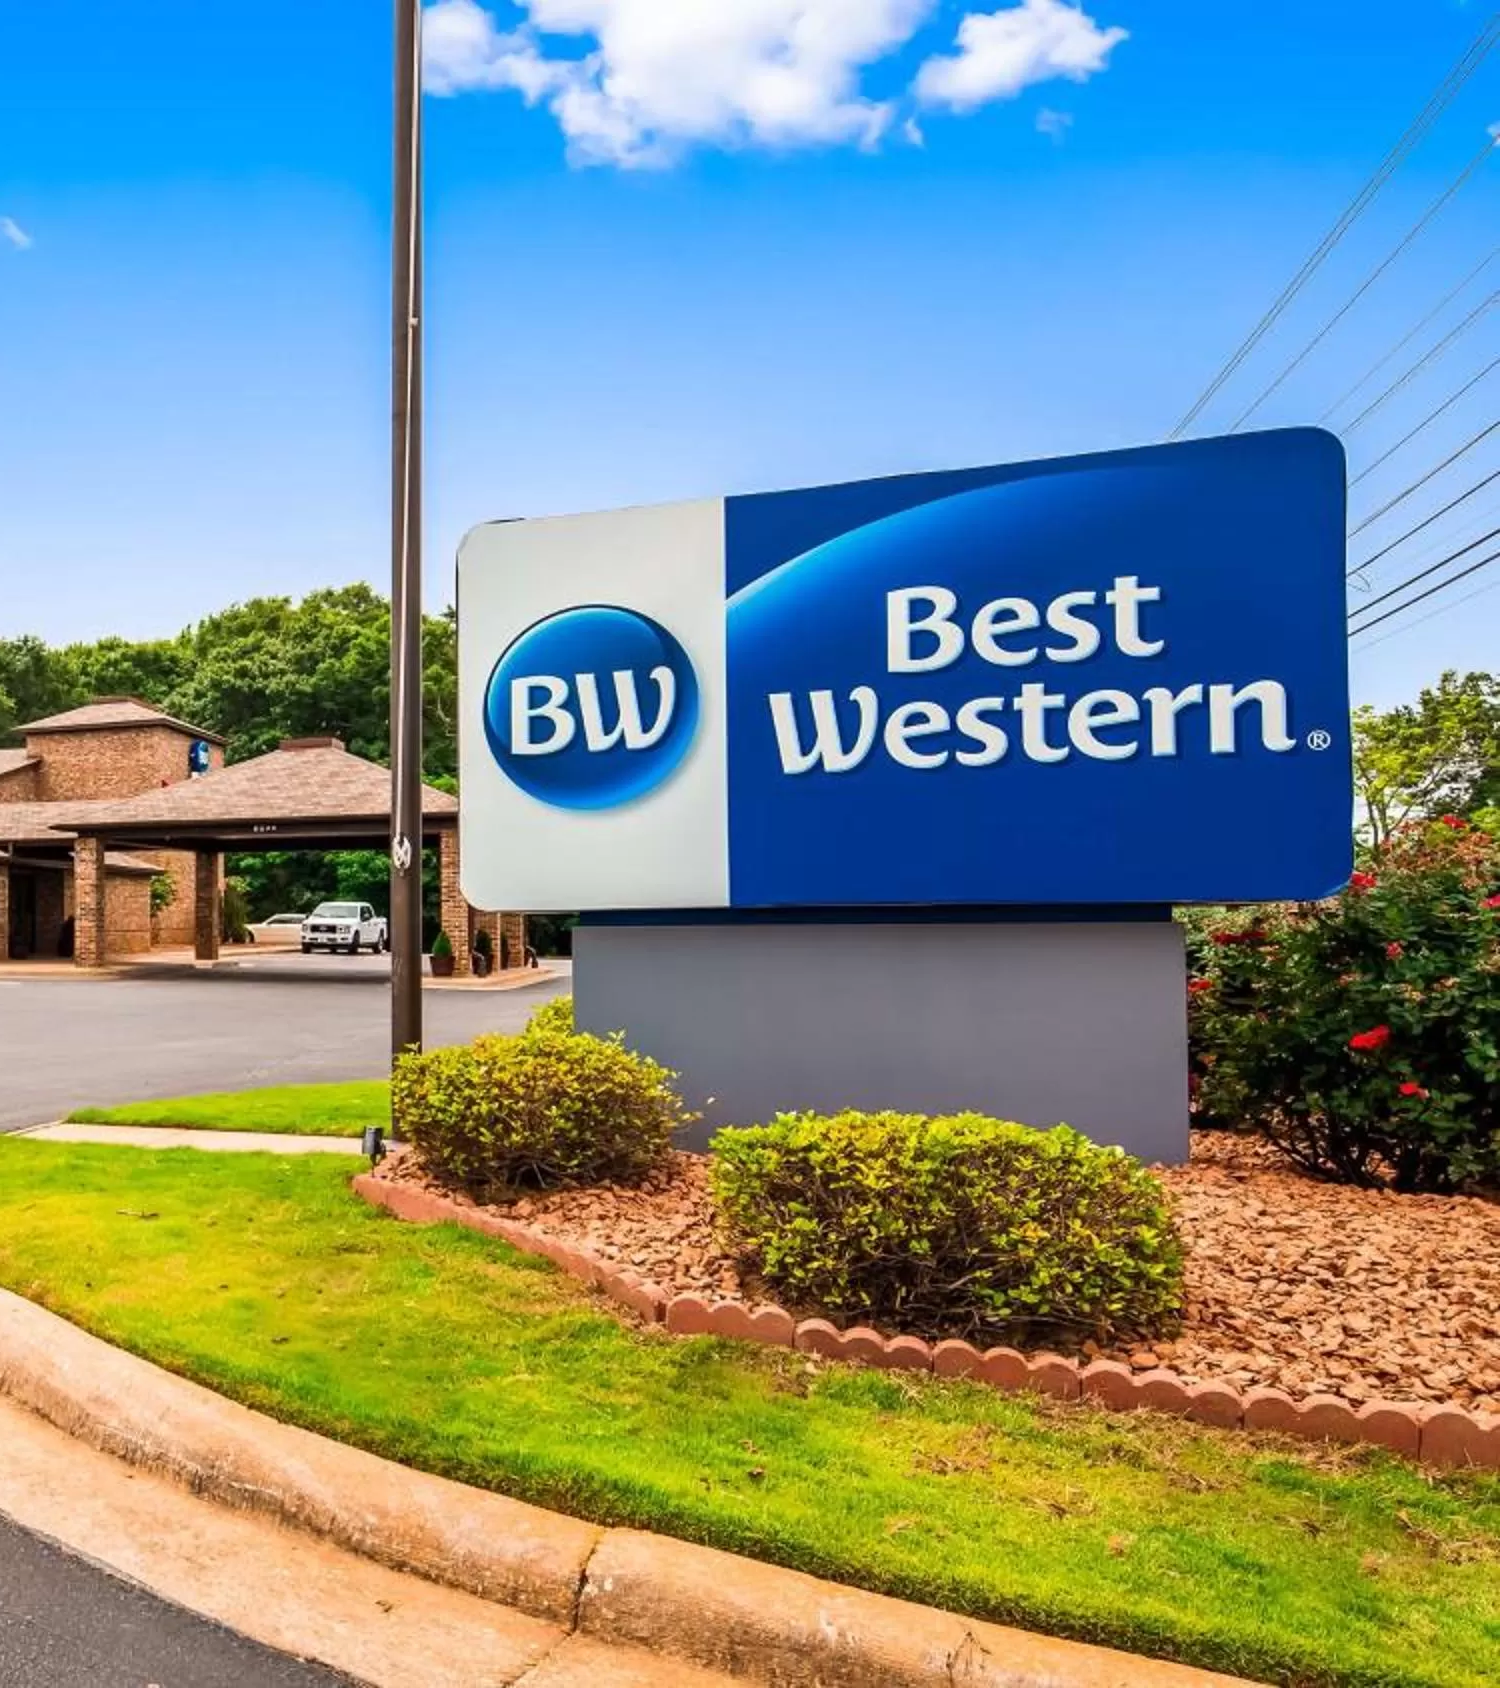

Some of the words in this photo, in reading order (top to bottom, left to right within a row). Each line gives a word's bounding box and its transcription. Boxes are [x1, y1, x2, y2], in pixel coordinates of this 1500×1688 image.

[886, 574, 1165, 673] Best
[510, 665, 675, 756] BW
[769, 679, 1297, 775] Western
